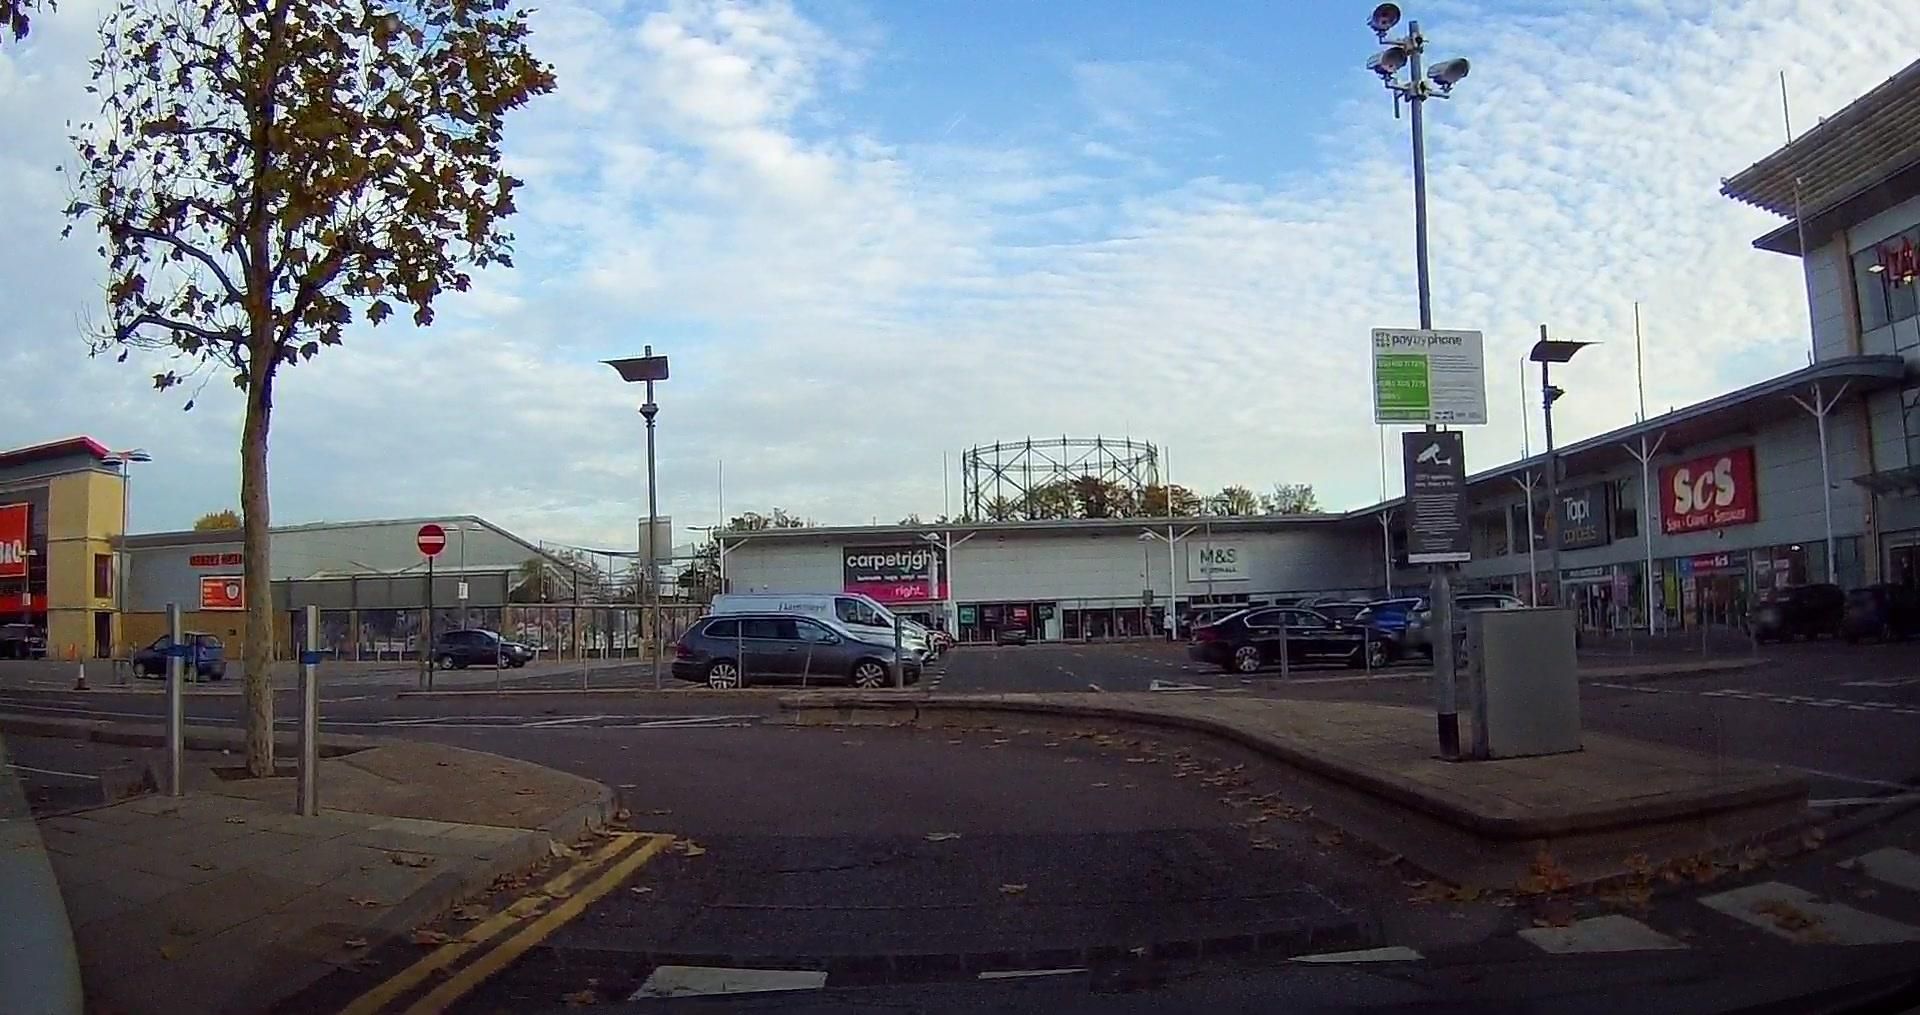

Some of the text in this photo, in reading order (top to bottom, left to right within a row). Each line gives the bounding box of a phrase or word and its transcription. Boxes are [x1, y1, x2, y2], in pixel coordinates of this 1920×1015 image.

[1392, 333, 1463, 347] paybyphone
[1673, 457, 1736, 515] ScS
[1563, 497, 1590, 525] Tapi
[1200, 548, 1236, 564] M&S
